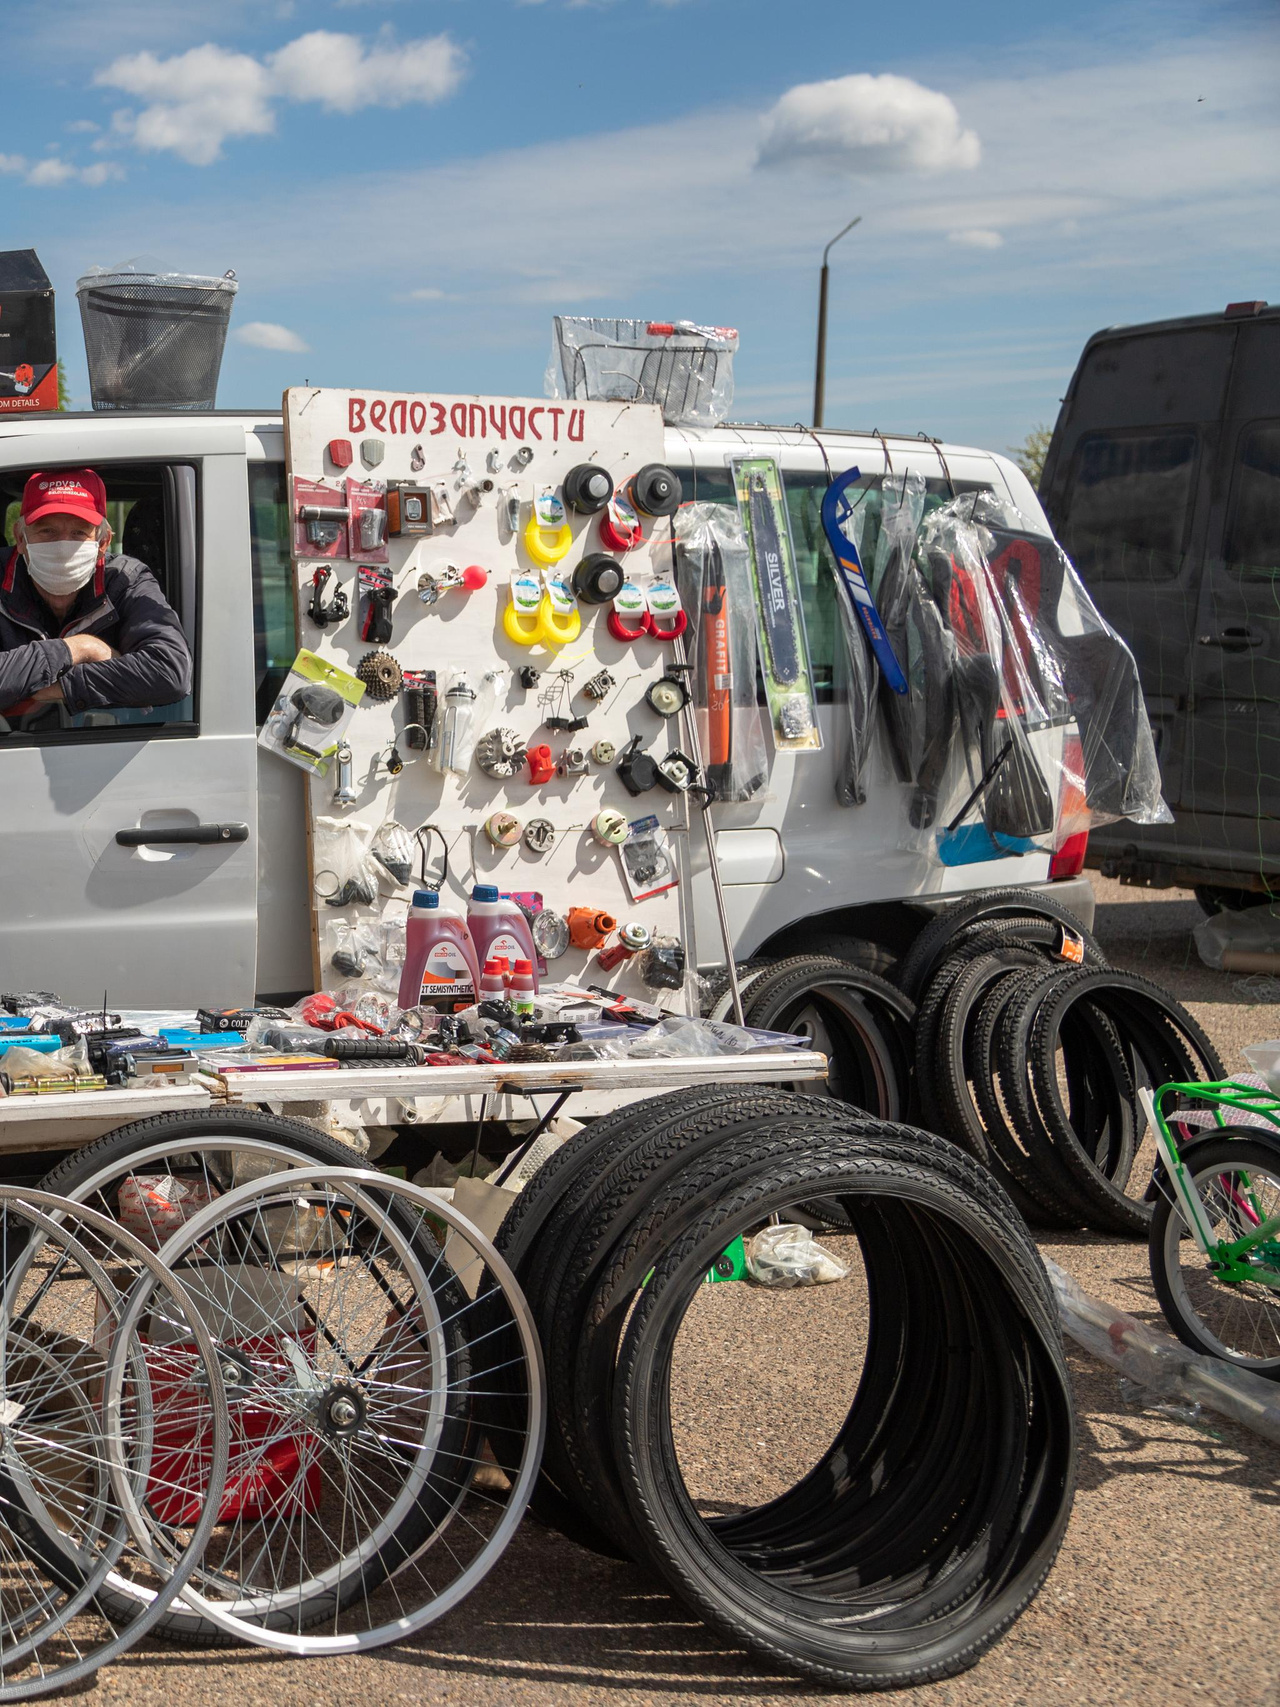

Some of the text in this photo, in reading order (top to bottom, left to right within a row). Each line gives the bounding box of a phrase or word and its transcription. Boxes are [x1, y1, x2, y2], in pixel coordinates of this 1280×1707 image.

[11, 398, 40, 408] DETAILS
[49, 480, 83, 488] PDVSA
[767, 552, 786, 611] SILVER
[715, 619, 727, 673] GRAFIT
[429, 984, 474, 994] SEMISYNTHETIC
[230, 1019, 251, 1028] COLD
